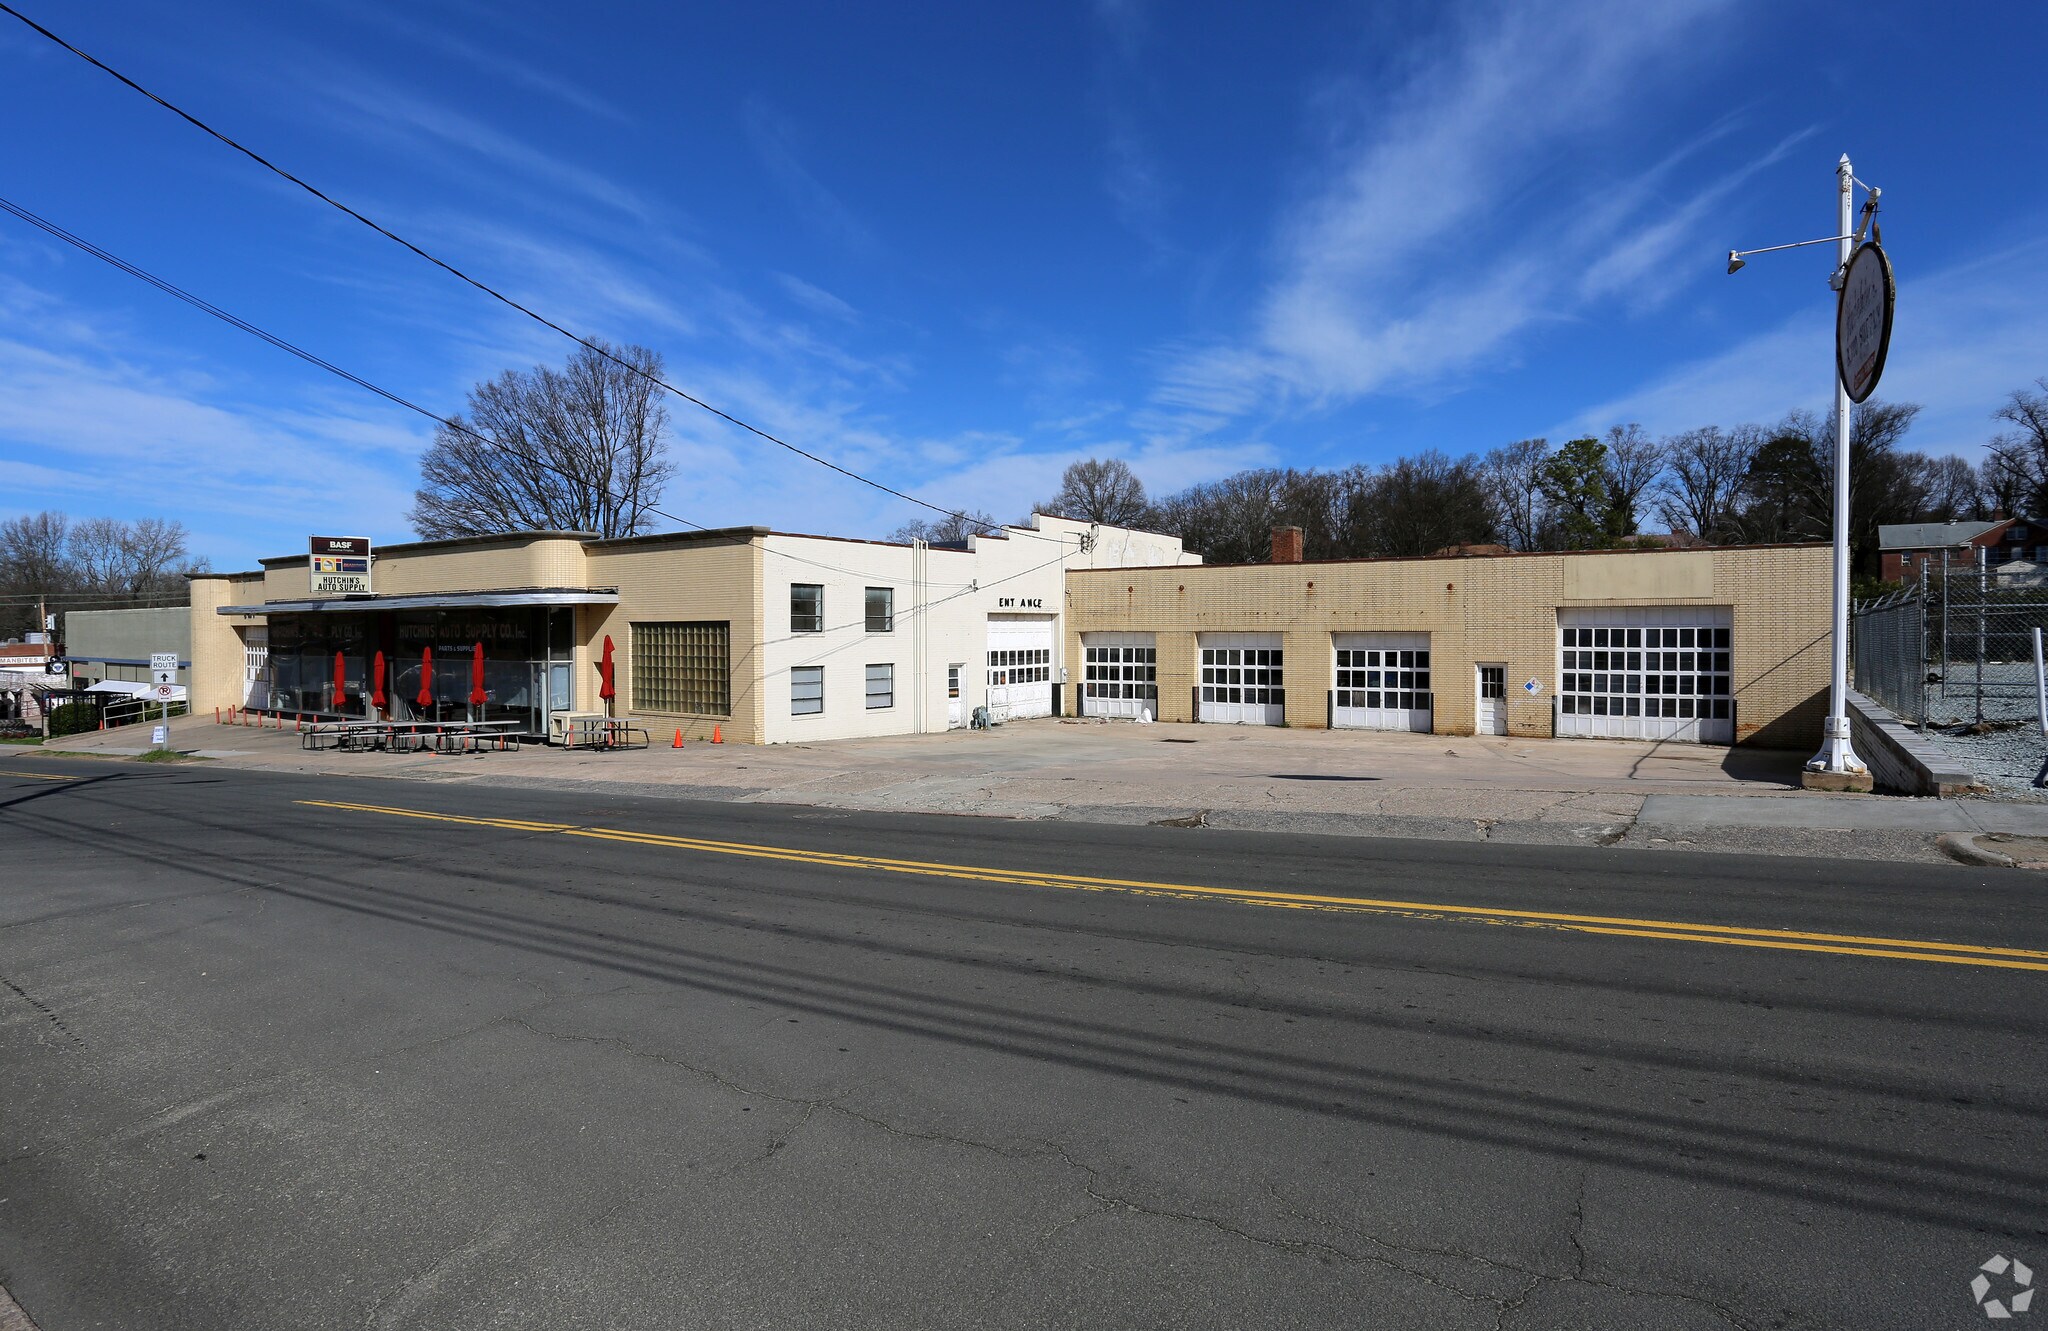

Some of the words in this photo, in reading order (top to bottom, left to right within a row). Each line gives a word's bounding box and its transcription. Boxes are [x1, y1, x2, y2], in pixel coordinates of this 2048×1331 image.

[330, 541, 352, 549] BASF
[323, 576, 360, 584] HUTCHIN'S
[318, 583, 337, 591] AUTO
[439, 624, 461, 638] AUTO
[465, 624, 497, 639] SUPPLY
